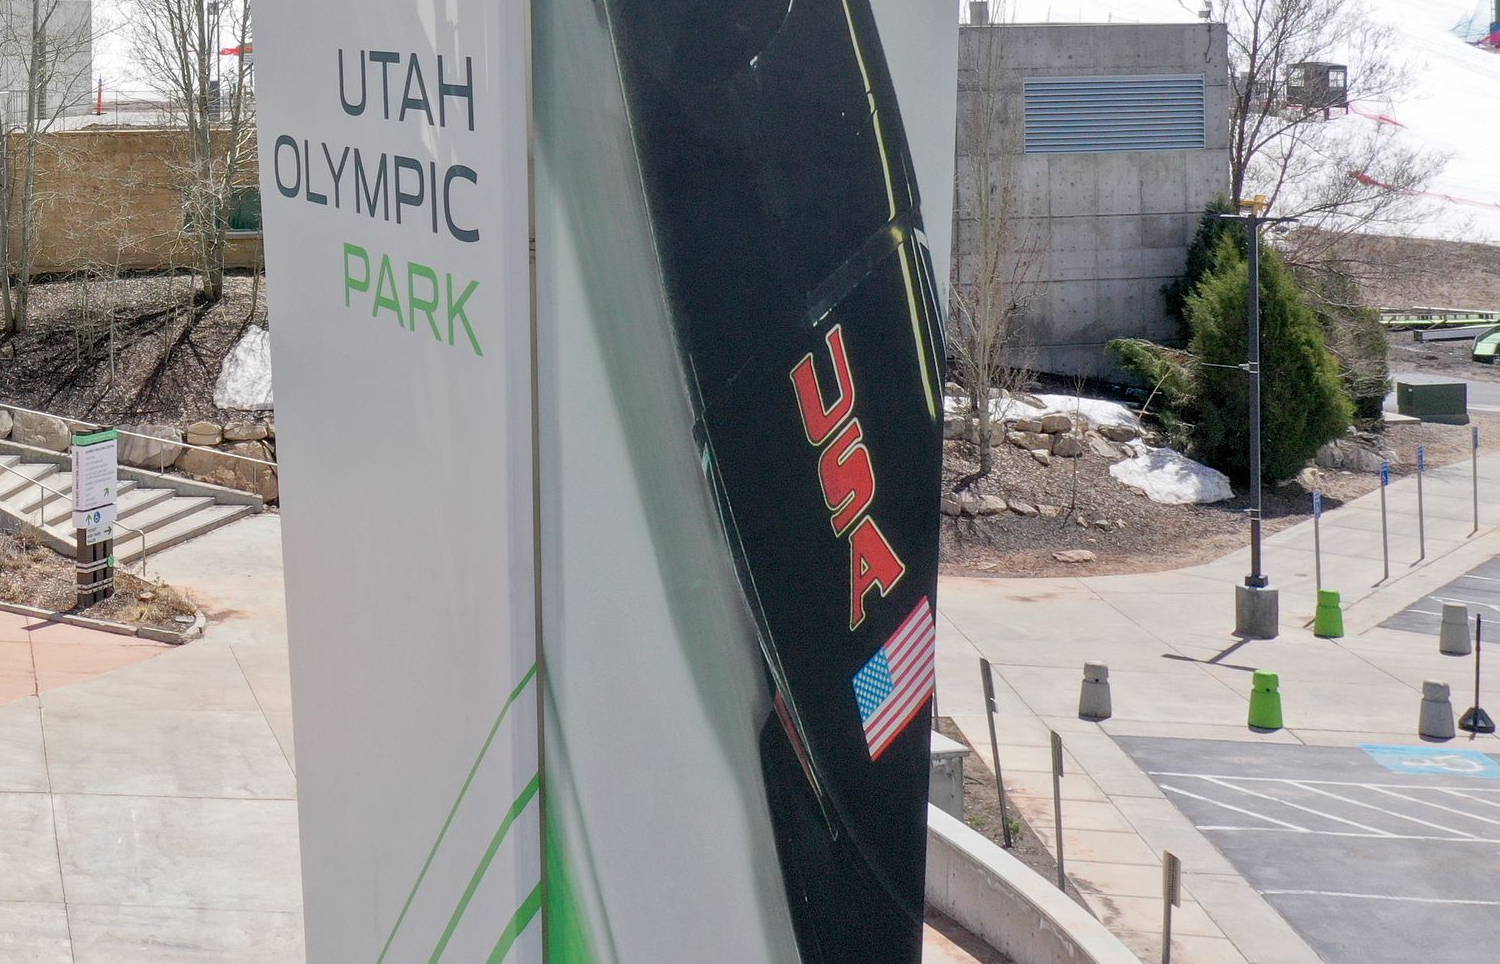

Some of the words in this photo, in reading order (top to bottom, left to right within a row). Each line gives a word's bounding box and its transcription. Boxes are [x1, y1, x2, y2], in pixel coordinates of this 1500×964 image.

[338, 48, 475, 132] UTAH
[273, 134, 480, 243] OLYMPIC
[343, 242, 484, 358] PARK
[789, 323, 906, 632] USA
